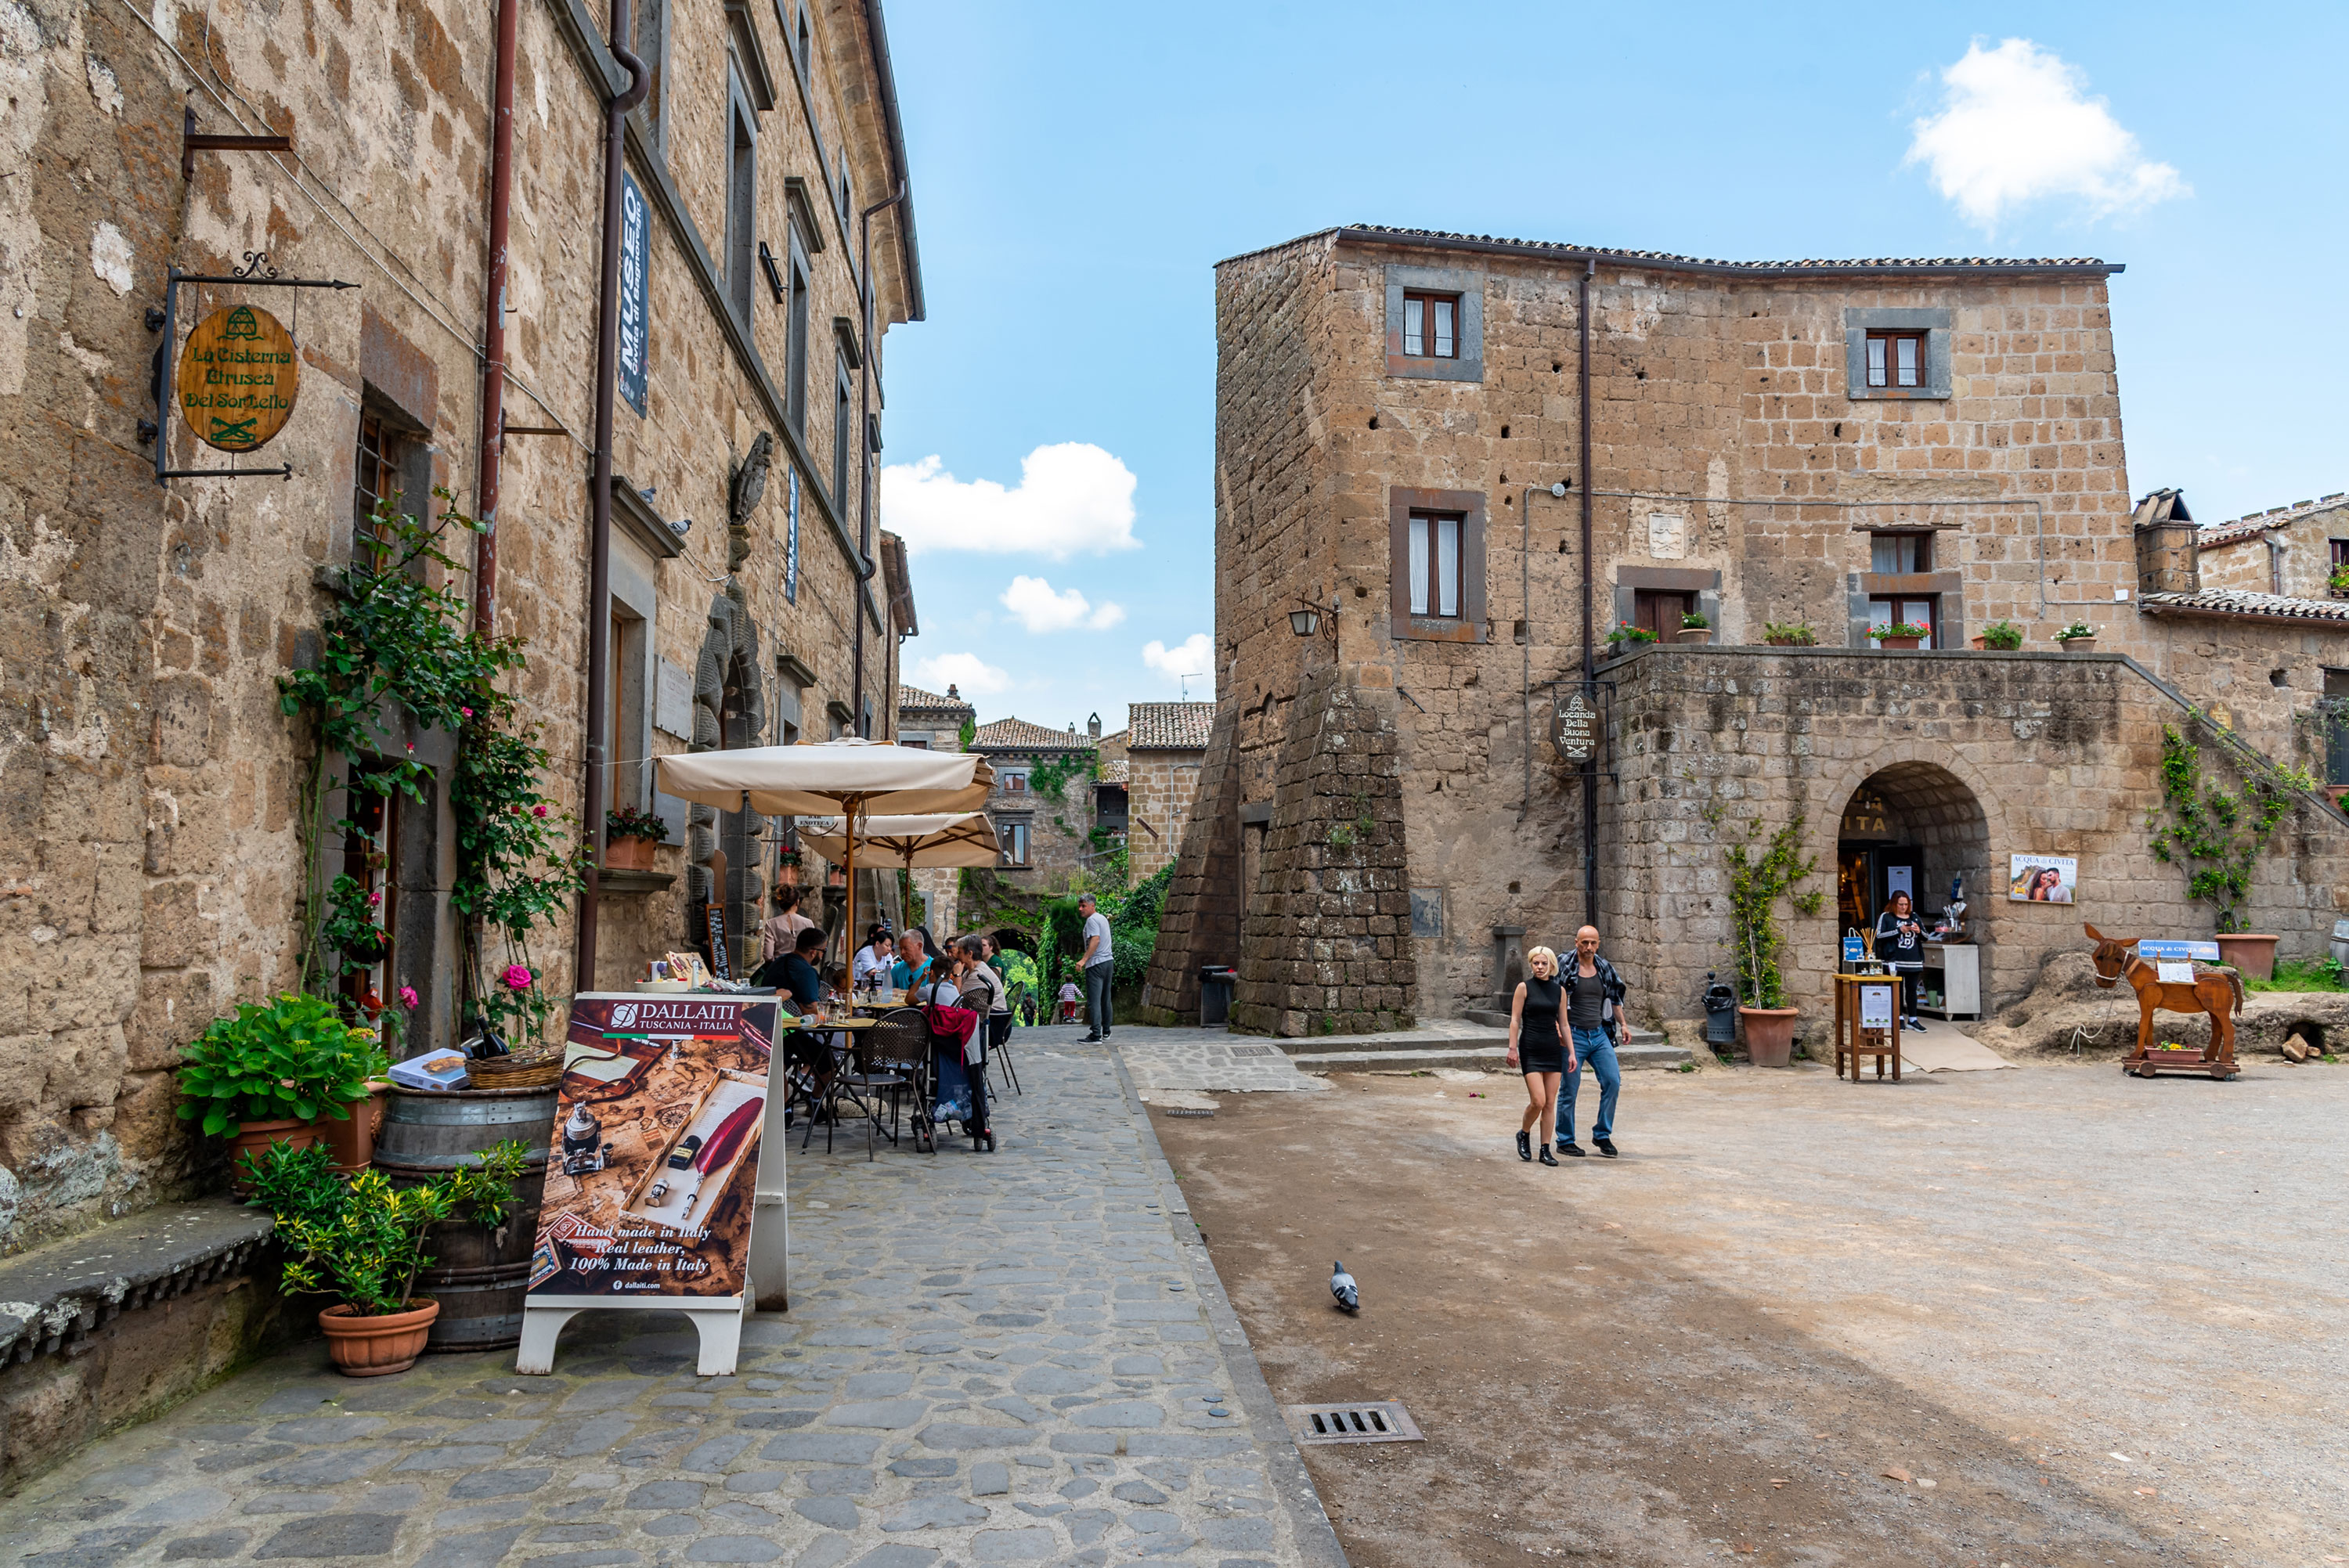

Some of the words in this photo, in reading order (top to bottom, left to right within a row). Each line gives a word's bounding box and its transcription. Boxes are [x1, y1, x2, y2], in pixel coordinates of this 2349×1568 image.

[622, 186, 636, 371] MUSEO
[633, 304, 640, 322] di
[191, 348, 215, 362] La
[218, 348, 291, 364] Cisterna
[186, 393, 213, 408] Del
[1558, 709, 1596, 719] Locanda
[1565, 719, 1589, 727] Della
[1563, 727, 1590, 737] Buona
[1559, 736, 1595, 745] Ventura
[2015, 856, 2040, 864] ACQUA
[640, 1004, 736, 1020] DALLAITI
[640, 1020, 691, 1029] TUSCANIA
[699, 1022, 733, 1030] ITALIA
[574, 1225, 614, 1238] Hand
[617, 1226, 655, 1238] made
[660, 1227, 676, 1238] in
[679, 1225, 711, 1241] Italy
[595, 1241, 629, 1254] Real
[633, 1242, 686, 1256] leather,
[568, 1257, 610, 1271] 100%
[613, 1257, 652, 1271] Made
[657, 1258, 672, 1271] in
[675, 1258, 709, 1274] Italy
